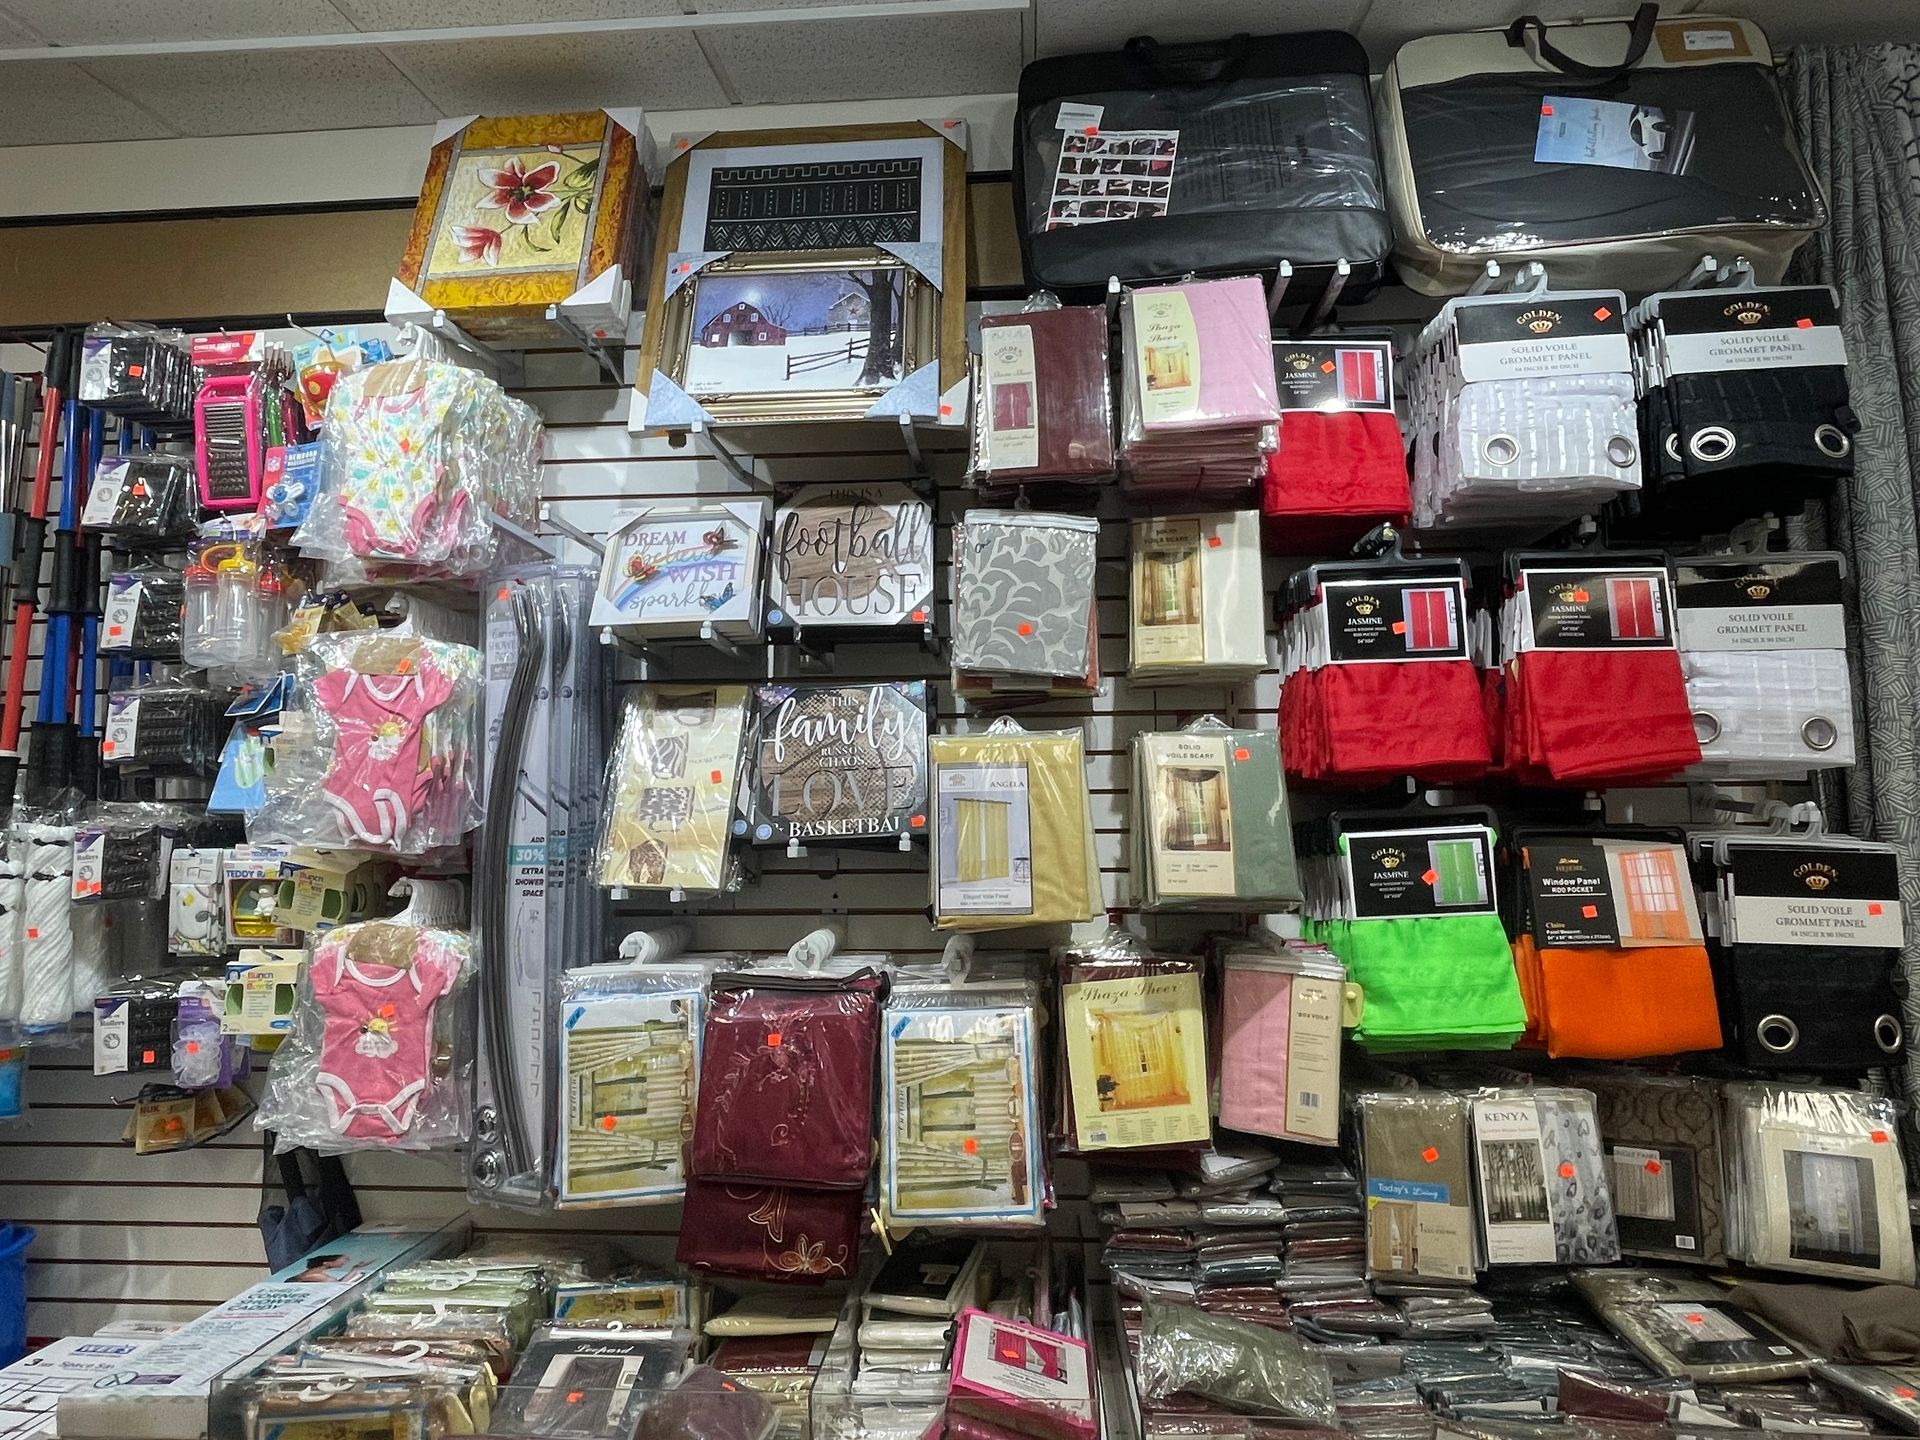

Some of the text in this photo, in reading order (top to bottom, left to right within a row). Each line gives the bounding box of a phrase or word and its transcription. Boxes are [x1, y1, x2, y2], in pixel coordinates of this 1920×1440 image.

[1723, 301, 1771, 316] GOLDEN
[1516, 309, 1563, 325] GOLDEN
[1720, 334, 1790, 346] SOLID VOILE
[1511, 343, 1578, 355] SOLID VOILE
[1709, 343, 1806, 357] GROMMET PANEL
[1500, 352, 1593, 366] GROMMET PANEL
[624, 530, 687, 547] DREAM
[773, 501, 934, 585] football
[668, 561, 738, 584] WISH
[781, 573, 922, 617] HOUSE
[1346, 595, 1381, 609] GOLDEN
[1551, 605, 1587, 613] JASMINE
[1347, 617, 1383, 626] JASMINE
[1728, 612, 1795, 622] SOLID VOILE
[1717, 624, 1808, 635] GROMMET PANEL
[831, 696, 859, 708] THIS
[762, 686, 921, 763] family
[821, 746, 846, 756] RUNS
[1189, 752, 1215, 760] SCARF
[990, 781, 1025, 789] ANGELA
[769, 766, 916, 817] LOVE
[516, 847, 545, 862] 30%
[1371, 847, 1408, 861] GOLDEN
[226, 870, 255, 878] TEDDY
[1373, 871, 1410, 880] JASMINE
[1793, 862, 1838, 879] GOLDEN
[514, 878, 544, 886] SHOWER
[1542, 877, 1601, 887] Window Panel
[522, 889, 544, 897] SPACE
[1567, 885, 1594, 893] POCKET
[1787, 905, 1853, 915] SOLID VOILE
[1776, 917, 1867, 928] GROMMET PANEL
[1080, 982, 1178, 1004] Shaza Sheer
[222, 1023, 229, 1032] 2
[1484, 1111, 1529, 1122] KENYA
[1378, 1182, 1409, 1195] Today's
[573, 1343, 636, 1356] Leopard
